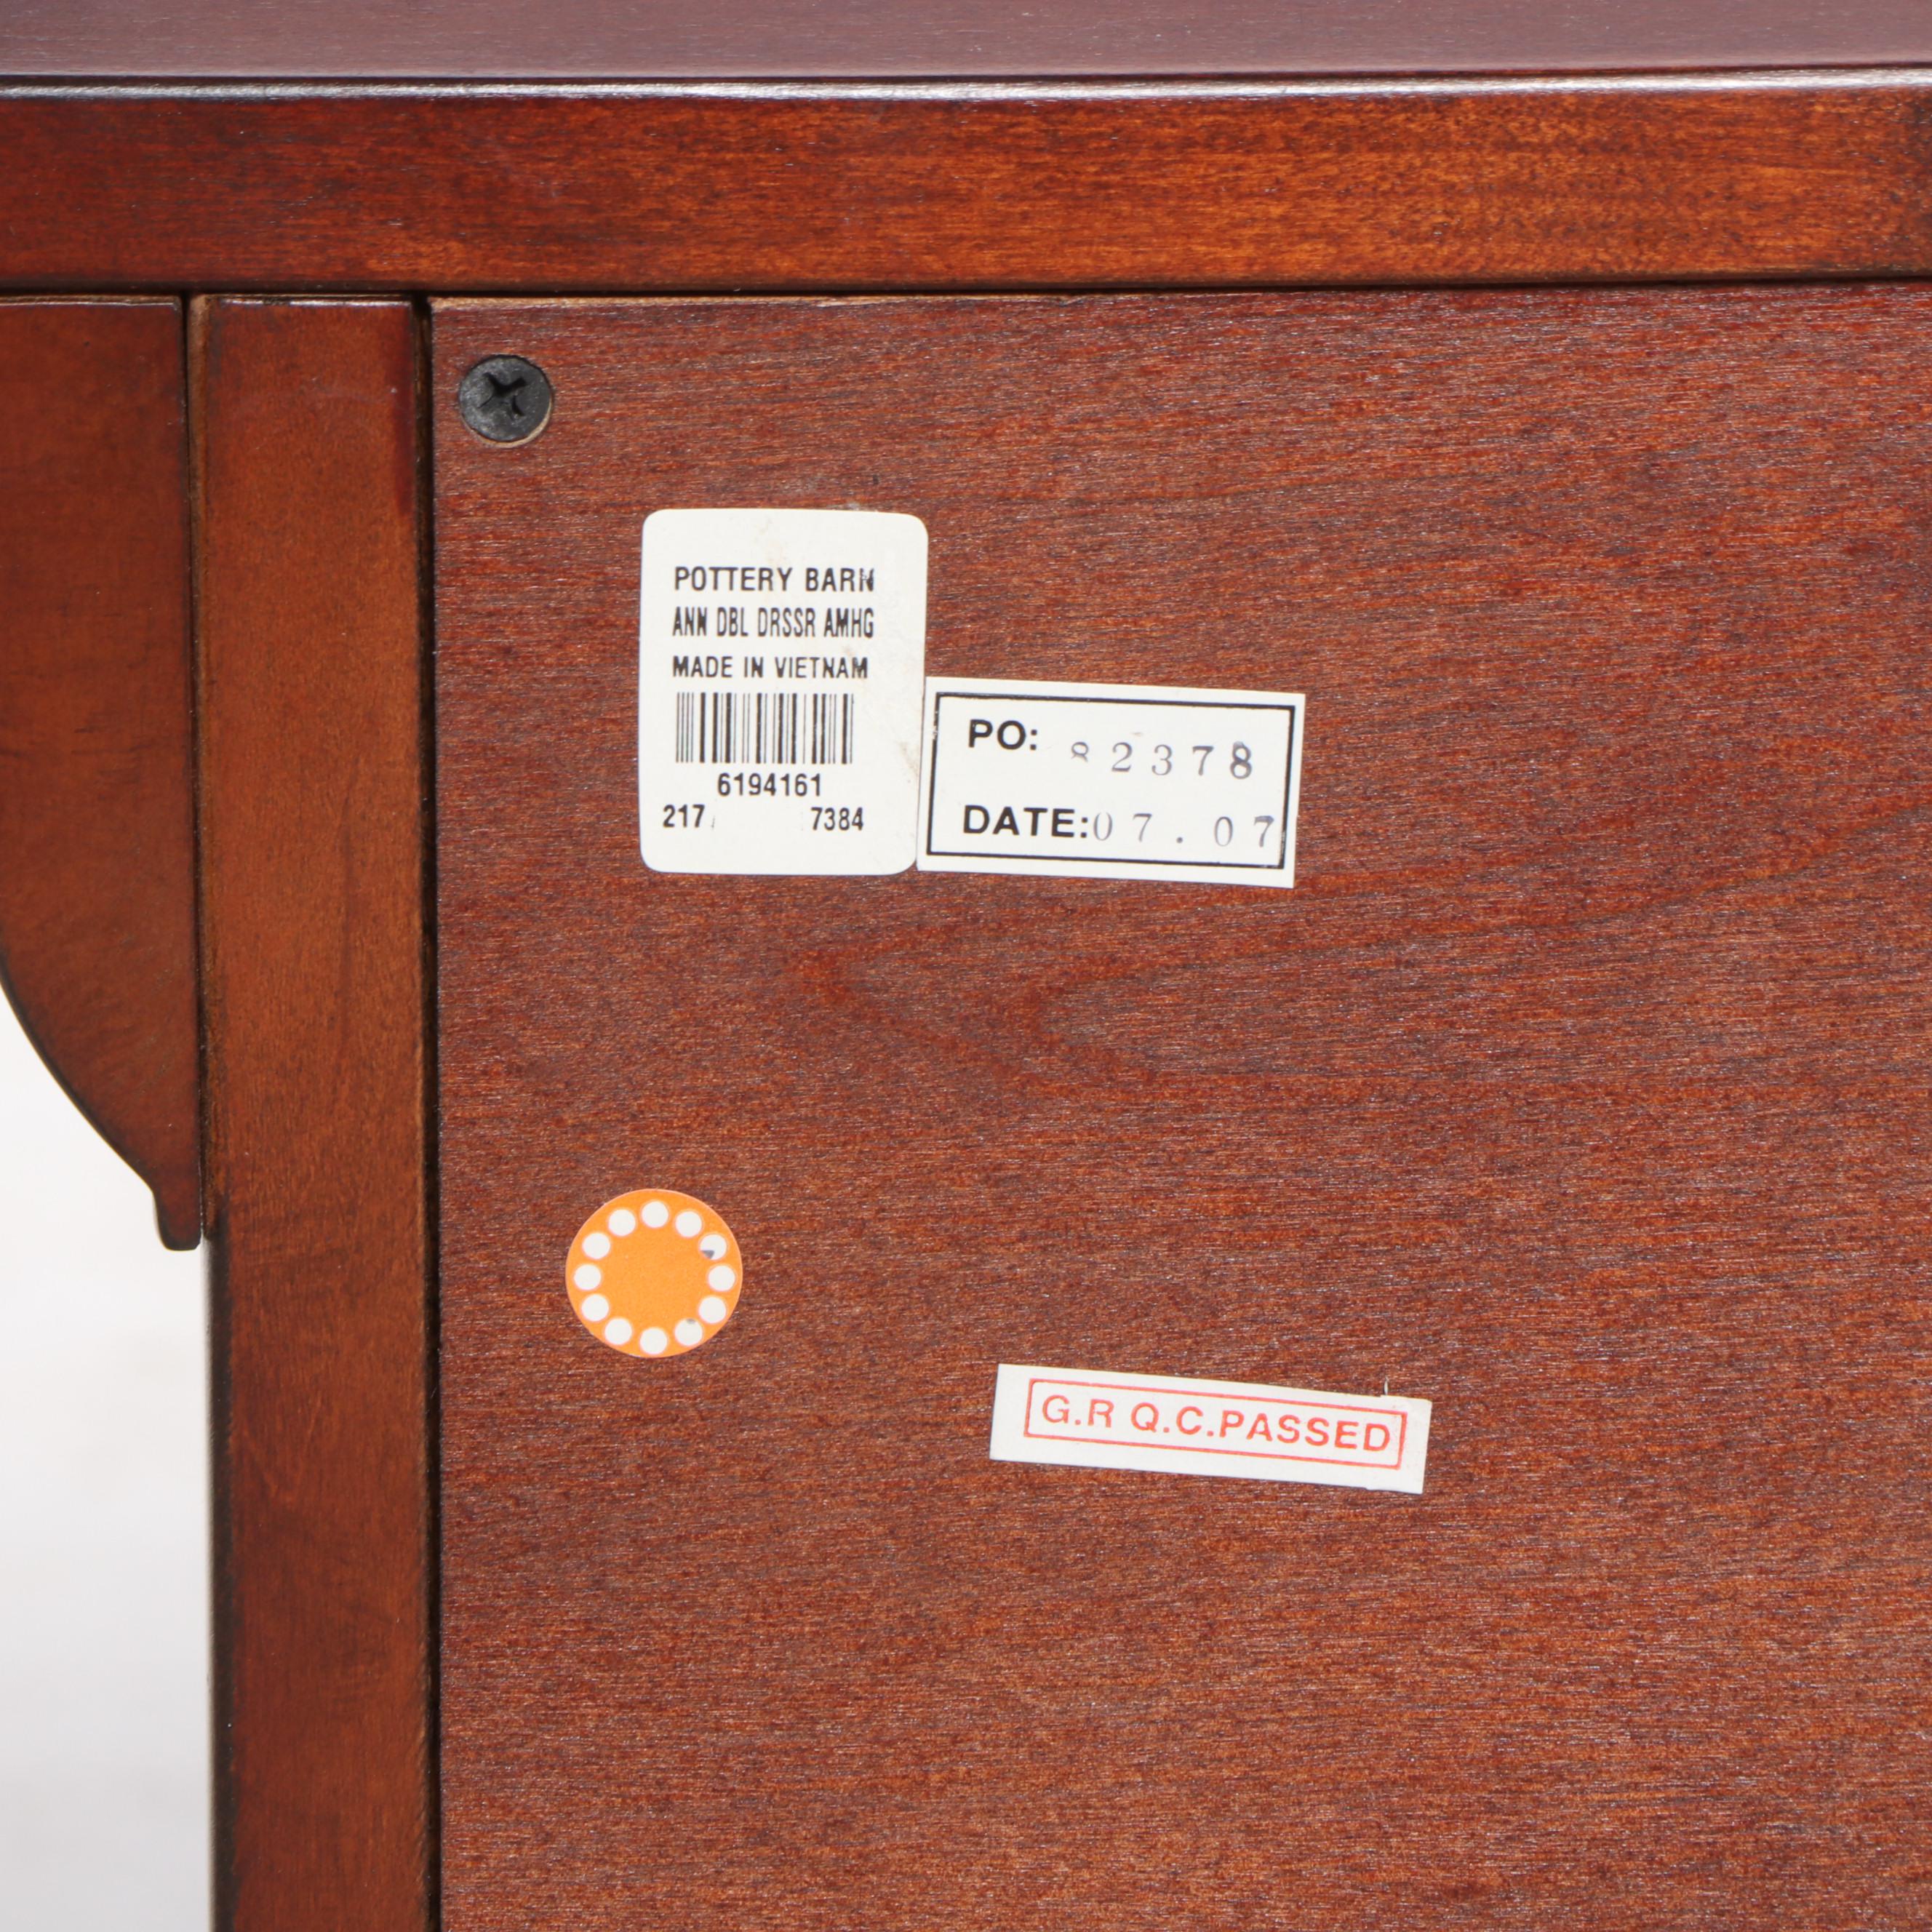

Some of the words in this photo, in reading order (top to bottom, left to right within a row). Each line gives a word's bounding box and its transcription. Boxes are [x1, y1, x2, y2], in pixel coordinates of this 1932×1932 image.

[674, 566, 792, 591] POTTERY
[805, 567, 874, 592] BARN
[672, 607, 707, 636] ANN
[716, 607, 749, 637] DBL
[757, 607, 815, 637] DRSSR
[823, 607, 874, 639] AMHG
[673, 655, 733, 679] MADE
[744, 657, 763, 678] IN
[775, 657, 868, 679] VIETNAM
[968, 719, 1037, 751] PO:
[717, 773, 821, 797] 6194161
[663, 804, 705, 829] 217
[811, 807, 863, 831] 7384
[963, 805, 1088, 838] DATE:
[1042, 1395, 1114, 1428] G.R
